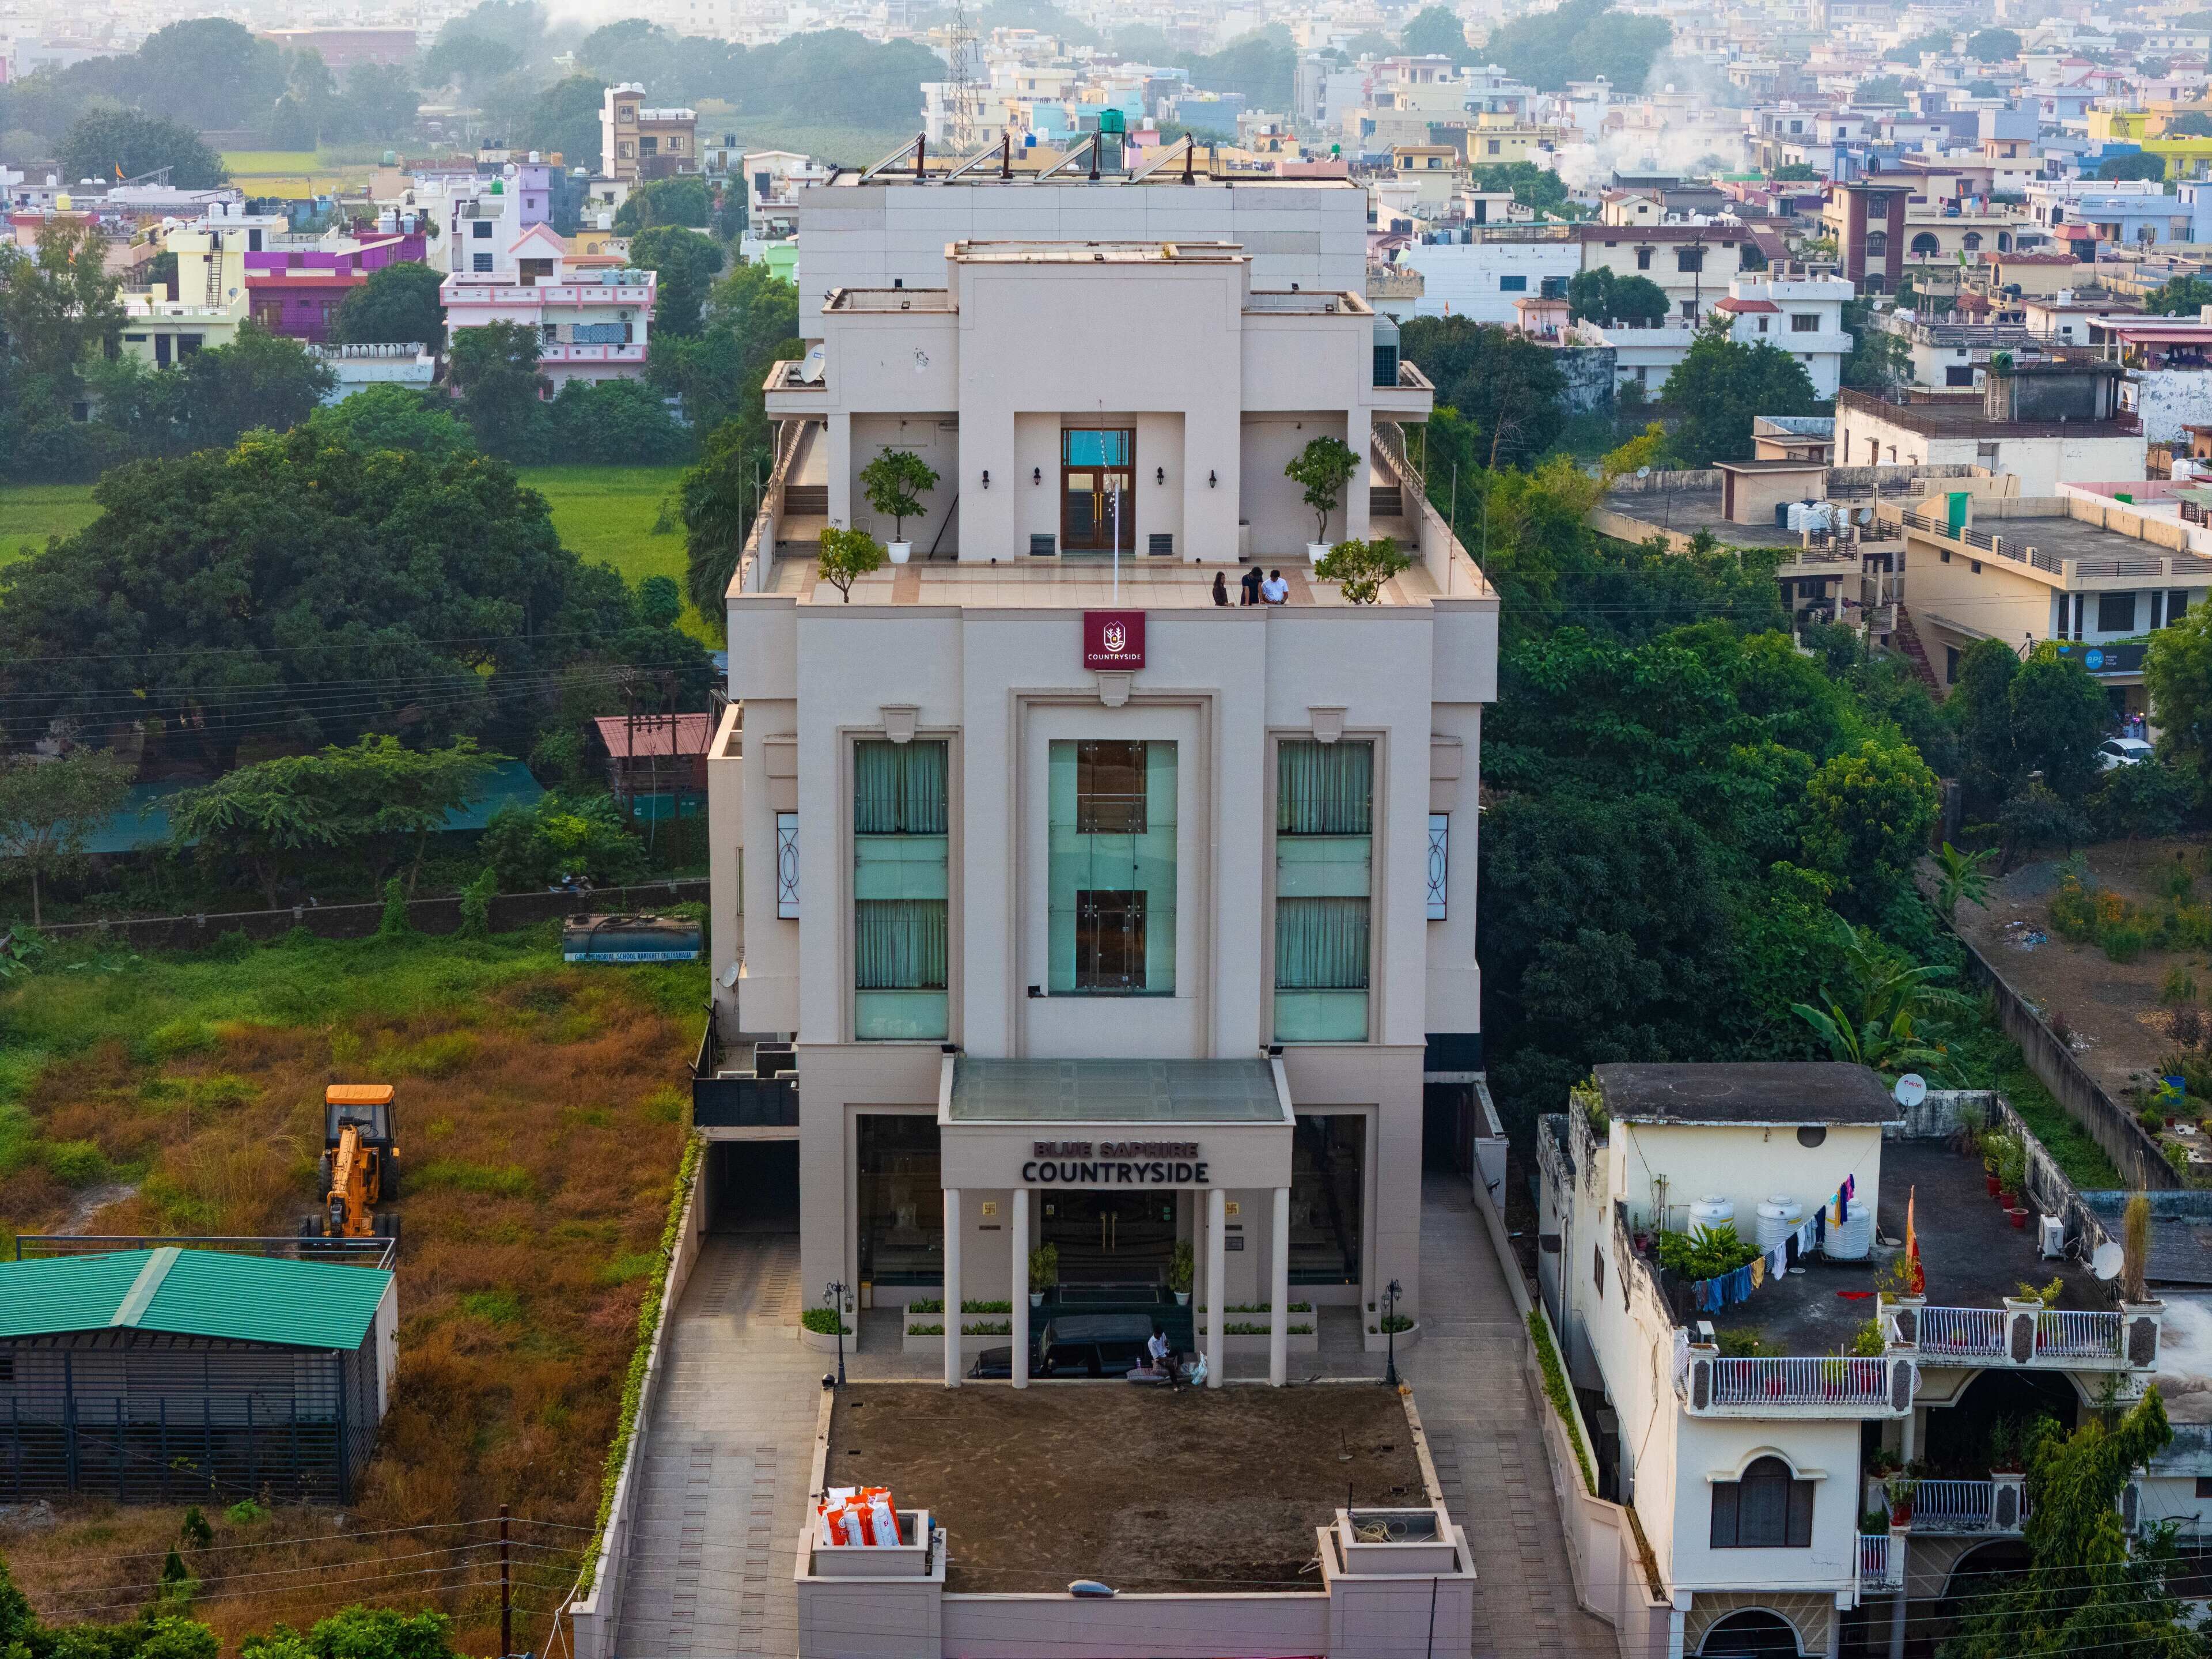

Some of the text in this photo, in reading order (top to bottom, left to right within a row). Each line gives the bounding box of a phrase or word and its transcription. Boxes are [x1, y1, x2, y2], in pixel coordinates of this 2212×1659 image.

[2087, 656, 2103, 664] BPL
[1034, 1141, 1199, 1158] BLUE SAPHIRE
[1022, 1161, 1209, 1183] COUNTRYSIDE
